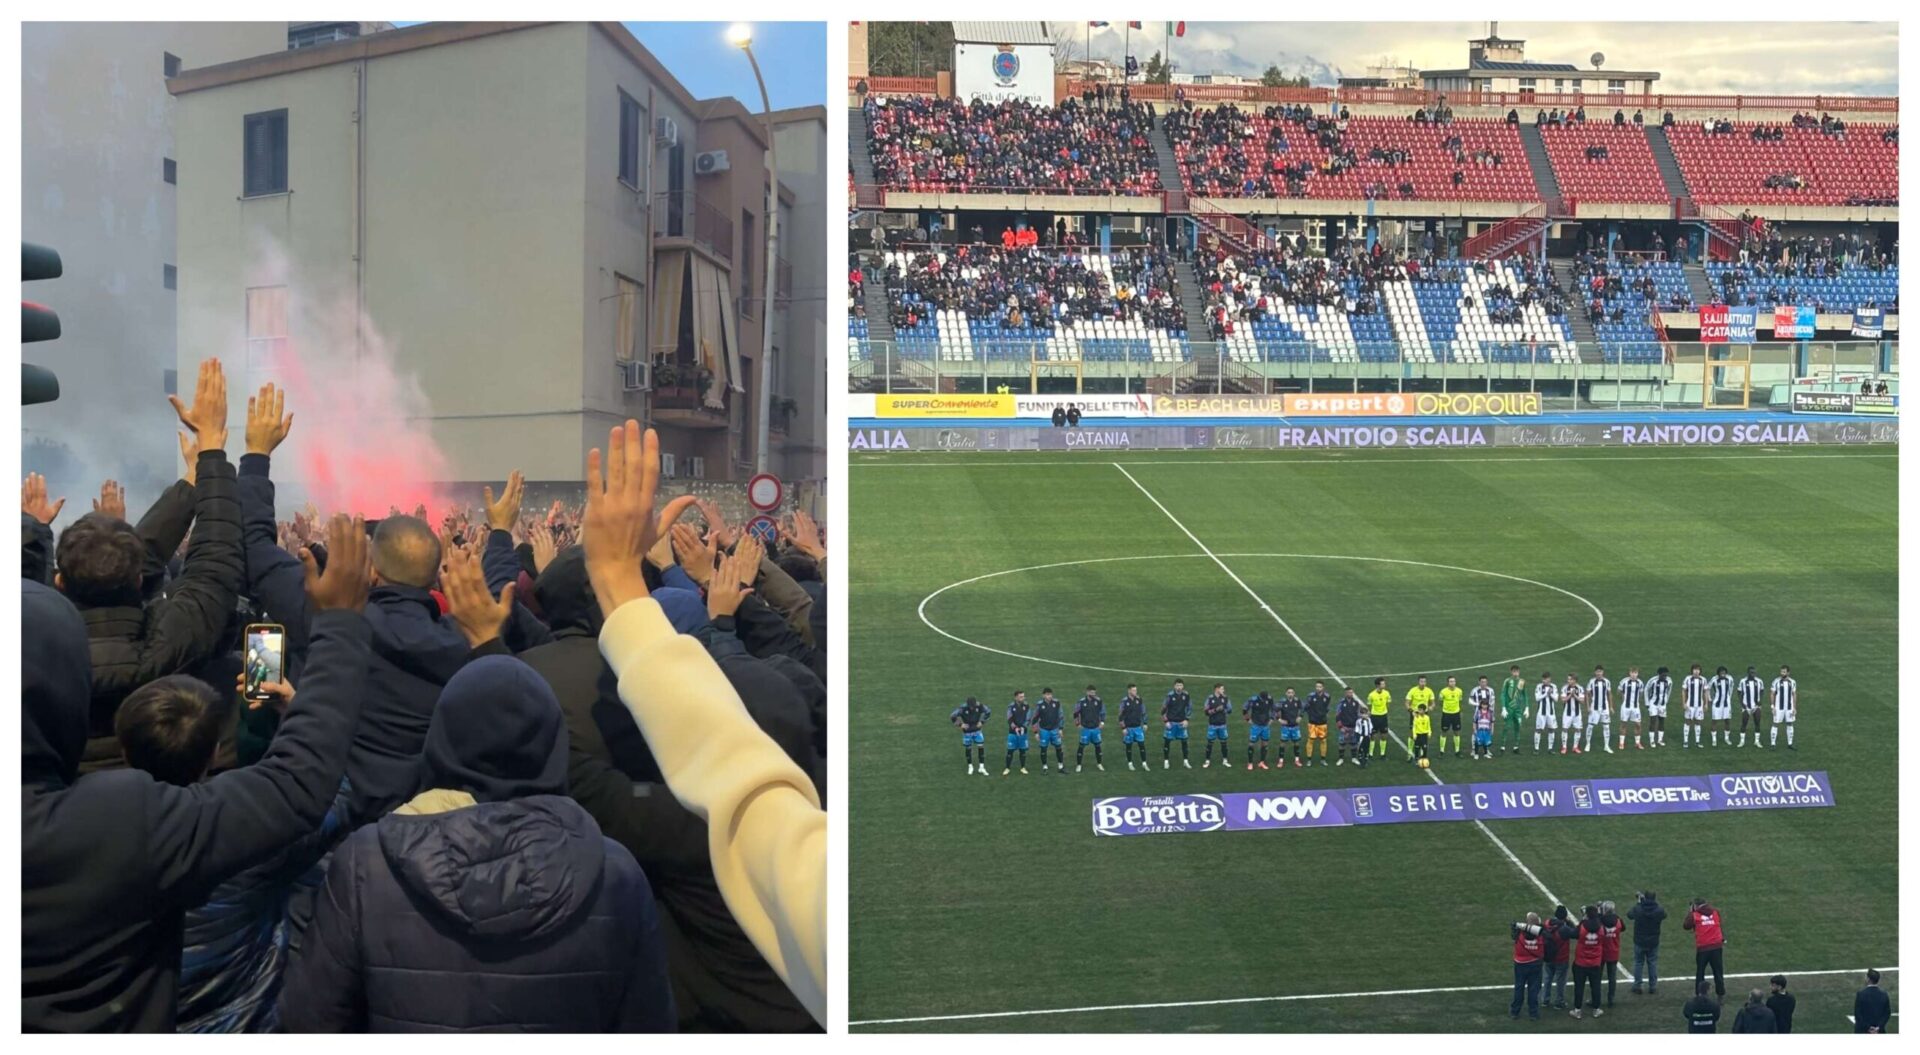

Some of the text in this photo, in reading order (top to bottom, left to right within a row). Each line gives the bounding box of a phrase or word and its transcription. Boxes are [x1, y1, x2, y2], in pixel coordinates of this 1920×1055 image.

[1708, 326, 1747, 337] CATANIA
[1176, 399, 1281, 412] BEACH CLUB
[1294, 396, 1384, 413] expert
[1801, 404, 1843, 412] system
[848, 429, 910, 449] ALIA
[1065, 431, 1130, 446] CATANIA
[1279, 426, 1486, 447] FRANTOIO SCALIA
[1731, 424, 1811, 443] SCALIA
[1721, 774, 1822, 796] CATTOLICA
[1142, 796, 1175, 806] Fratelli
[1247, 795, 1327, 822] NOW
[1389, 790, 1556, 813] SERIE C NOW
[1726, 794, 1826, 807] ASSICURAZIONI
[1097, 801, 1222, 830] Beretta
[1150, 825, 1174, 833] 1812
